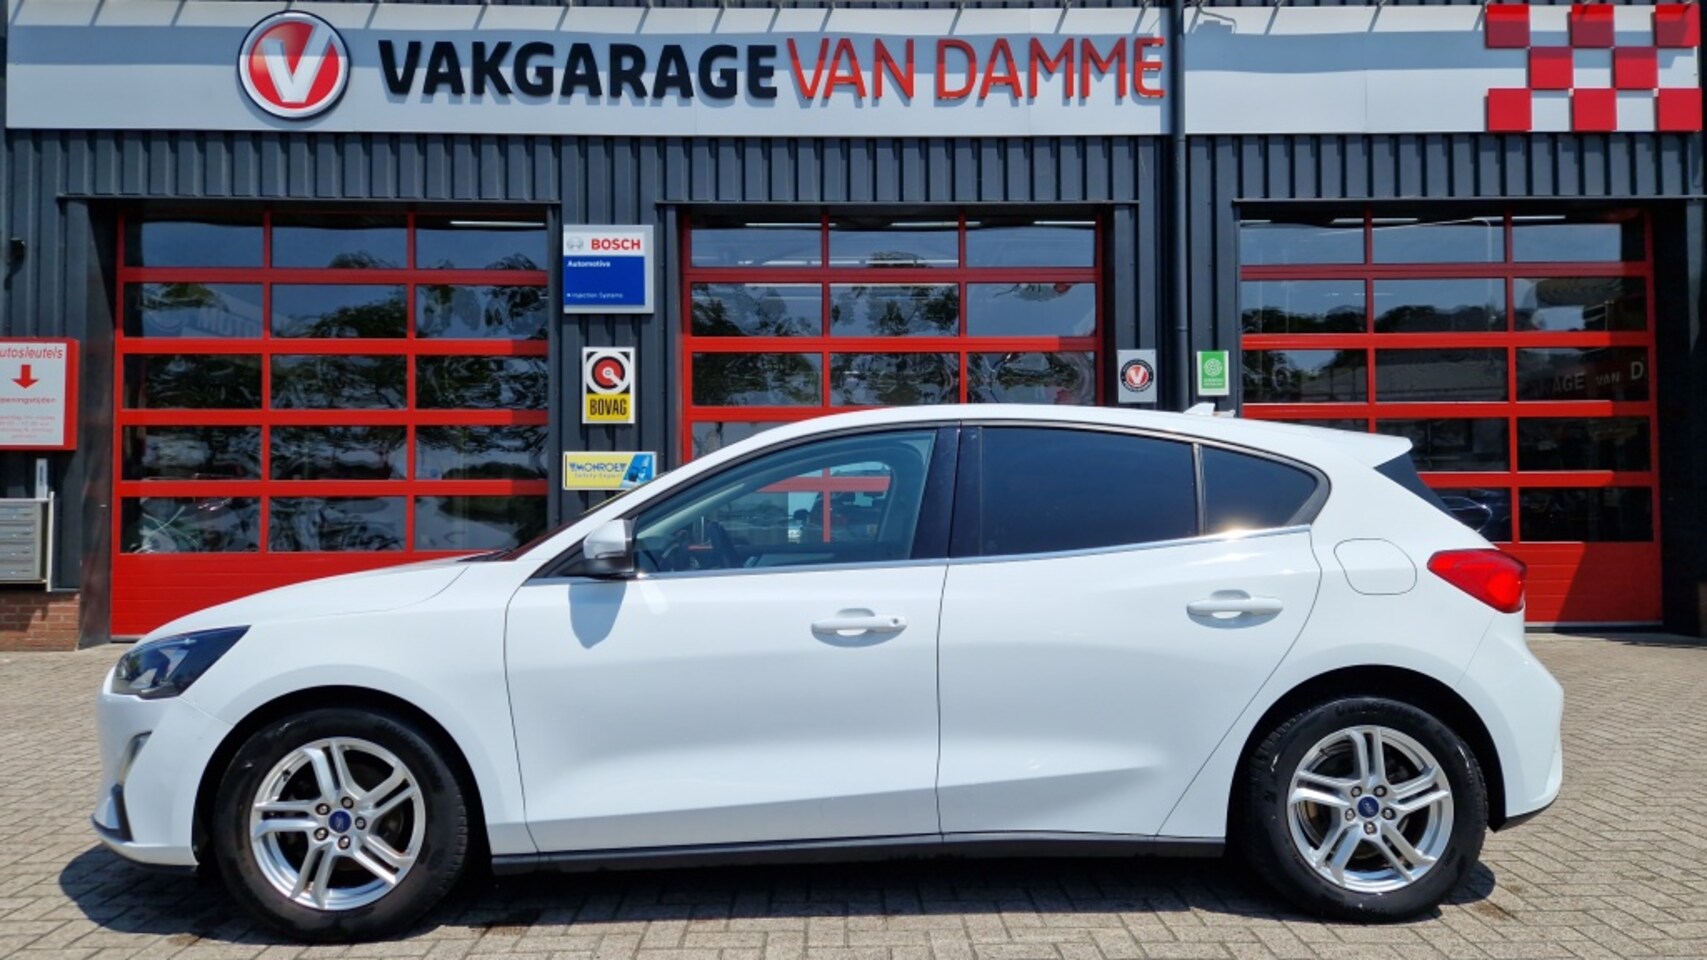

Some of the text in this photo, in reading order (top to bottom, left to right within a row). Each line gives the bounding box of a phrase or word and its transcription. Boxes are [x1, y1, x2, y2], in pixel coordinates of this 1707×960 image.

[377, 37, 1166, 100] VAKGARAGE VAN DAMME
[591, 238, 641, 250] BOSCH
[0, 346, 63, 359] utosleutels
[0, 396, 56, 405] peningstijden
[589, 398, 628, 416] BOVAG
[574, 462, 623, 473] MONROE
